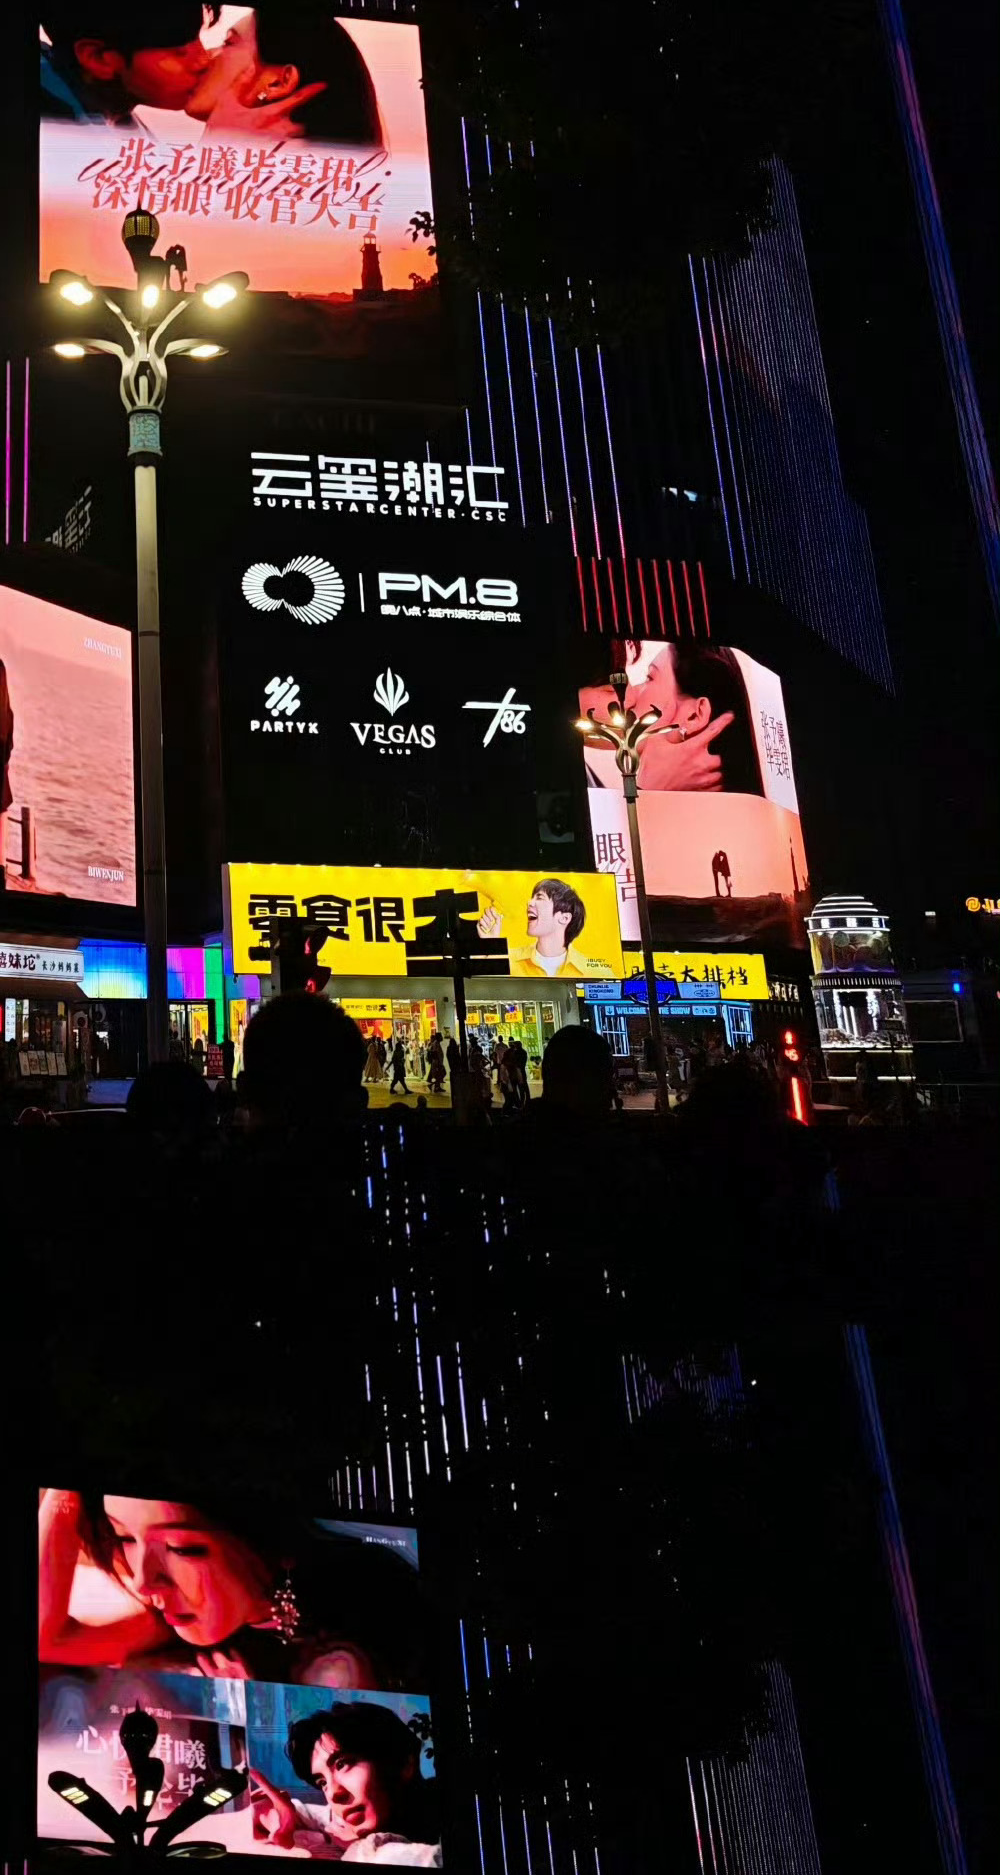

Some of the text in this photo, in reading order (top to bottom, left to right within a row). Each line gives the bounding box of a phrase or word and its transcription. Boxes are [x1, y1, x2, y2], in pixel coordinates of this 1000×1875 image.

[379, 572, 518, 608] PM.8
[250, 719, 318, 734] PARTYK
[351, 722, 436, 749] VEGAS
[380, 747, 411, 756] CLUB
